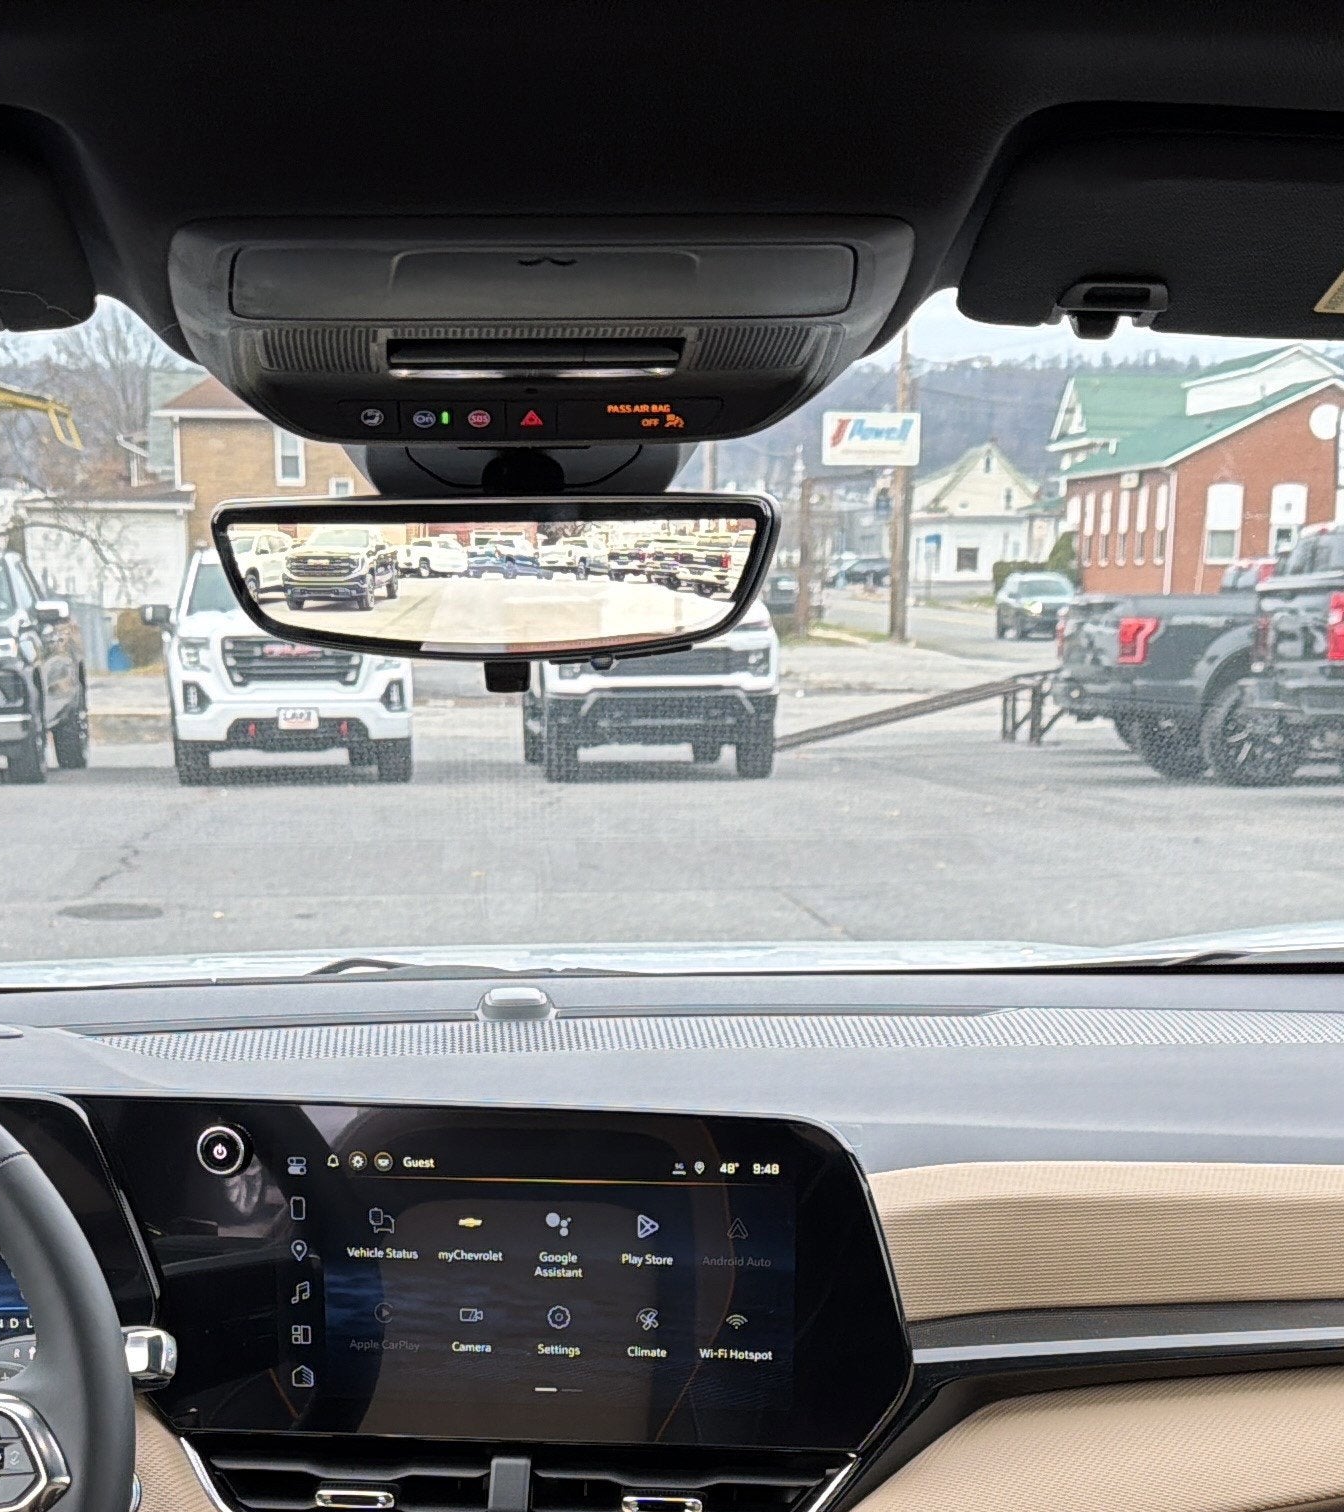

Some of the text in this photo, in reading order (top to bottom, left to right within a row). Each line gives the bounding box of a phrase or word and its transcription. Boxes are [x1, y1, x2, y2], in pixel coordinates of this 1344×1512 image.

[607, 404, 671, 414] PASS AIR BAG
[471, 415, 489, 424] SOS
[641, 417, 660, 427] OFF
[402, 1156, 436, 1169] Guest
[719, 1162, 740, 1175] 48°
[753, 1163, 780, 1175] 9:48
[346, 1246, 419, 1260] Vehicle Status
[437, 1249, 504, 1262] myChevrolet
[538, 1251, 578, 1265] Google
[621, 1253, 674, 1267] Play Store
[702, 1255, 772, 1268] Android Auto
[533, 1267, 584, 1278] Assistant
[9, 1318, 19, 1329] D
[26, 1318, 34, 1329] L
[349, 1339, 420, 1352] Apple CarPlay
[451, 1341, 492, 1353] Camera
[537, 1343, 581, 1358] Settings
[627, 1346, 668, 1358] Climate
[699, 1348, 773, 1362] Wi-Fi Hotspot
